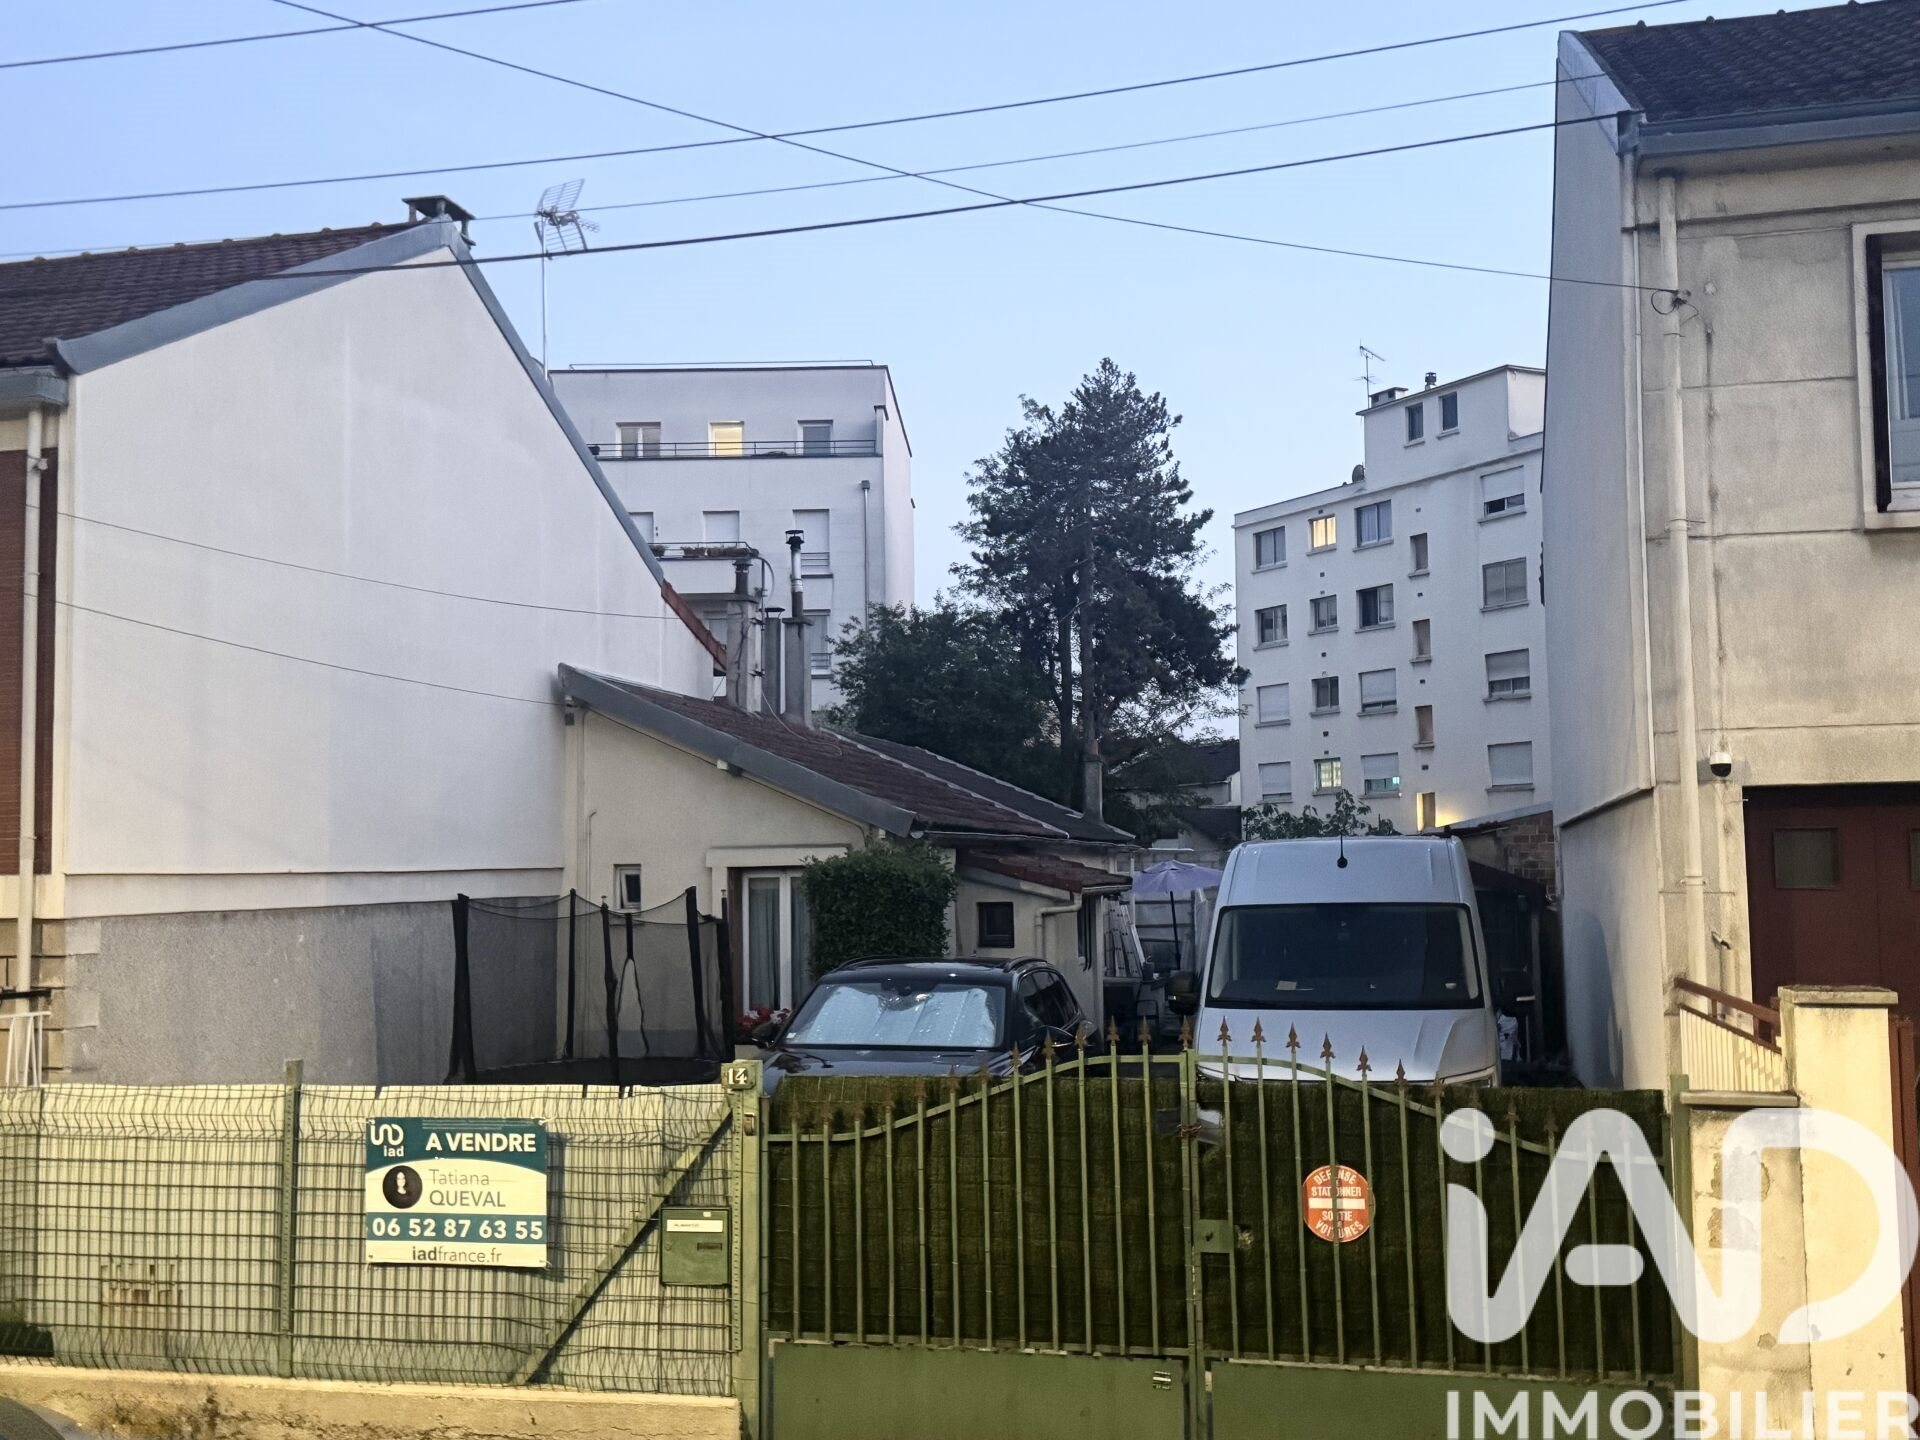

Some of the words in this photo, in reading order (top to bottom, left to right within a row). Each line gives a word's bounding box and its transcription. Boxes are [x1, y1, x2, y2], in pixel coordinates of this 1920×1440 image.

[728, 1067, 748, 1085] 14
[383, 1145, 404, 1157] iad
[425, 1132, 443, 1151] A
[446, 1132, 537, 1152] VENDRE
[428, 1168, 490, 1186] Tatiana
[1314, 1169, 1357, 1185] DEFNSE
[429, 1189, 507, 1207] QUEVAL
[1322, 1210, 1353, 1221] SOTIE
[372, 1217, 401, 1237] 06
[408, 1218, 437, 1237] 52
[444, 1218, 471, 1238] 87
[479, 1219, 507, 1239] 63
[515, 1220, 543, 1240] 55
[1316, 1219, 1364, 1239] VOIURES
[412, 1246, 503, 1263] iadfrance.fr
